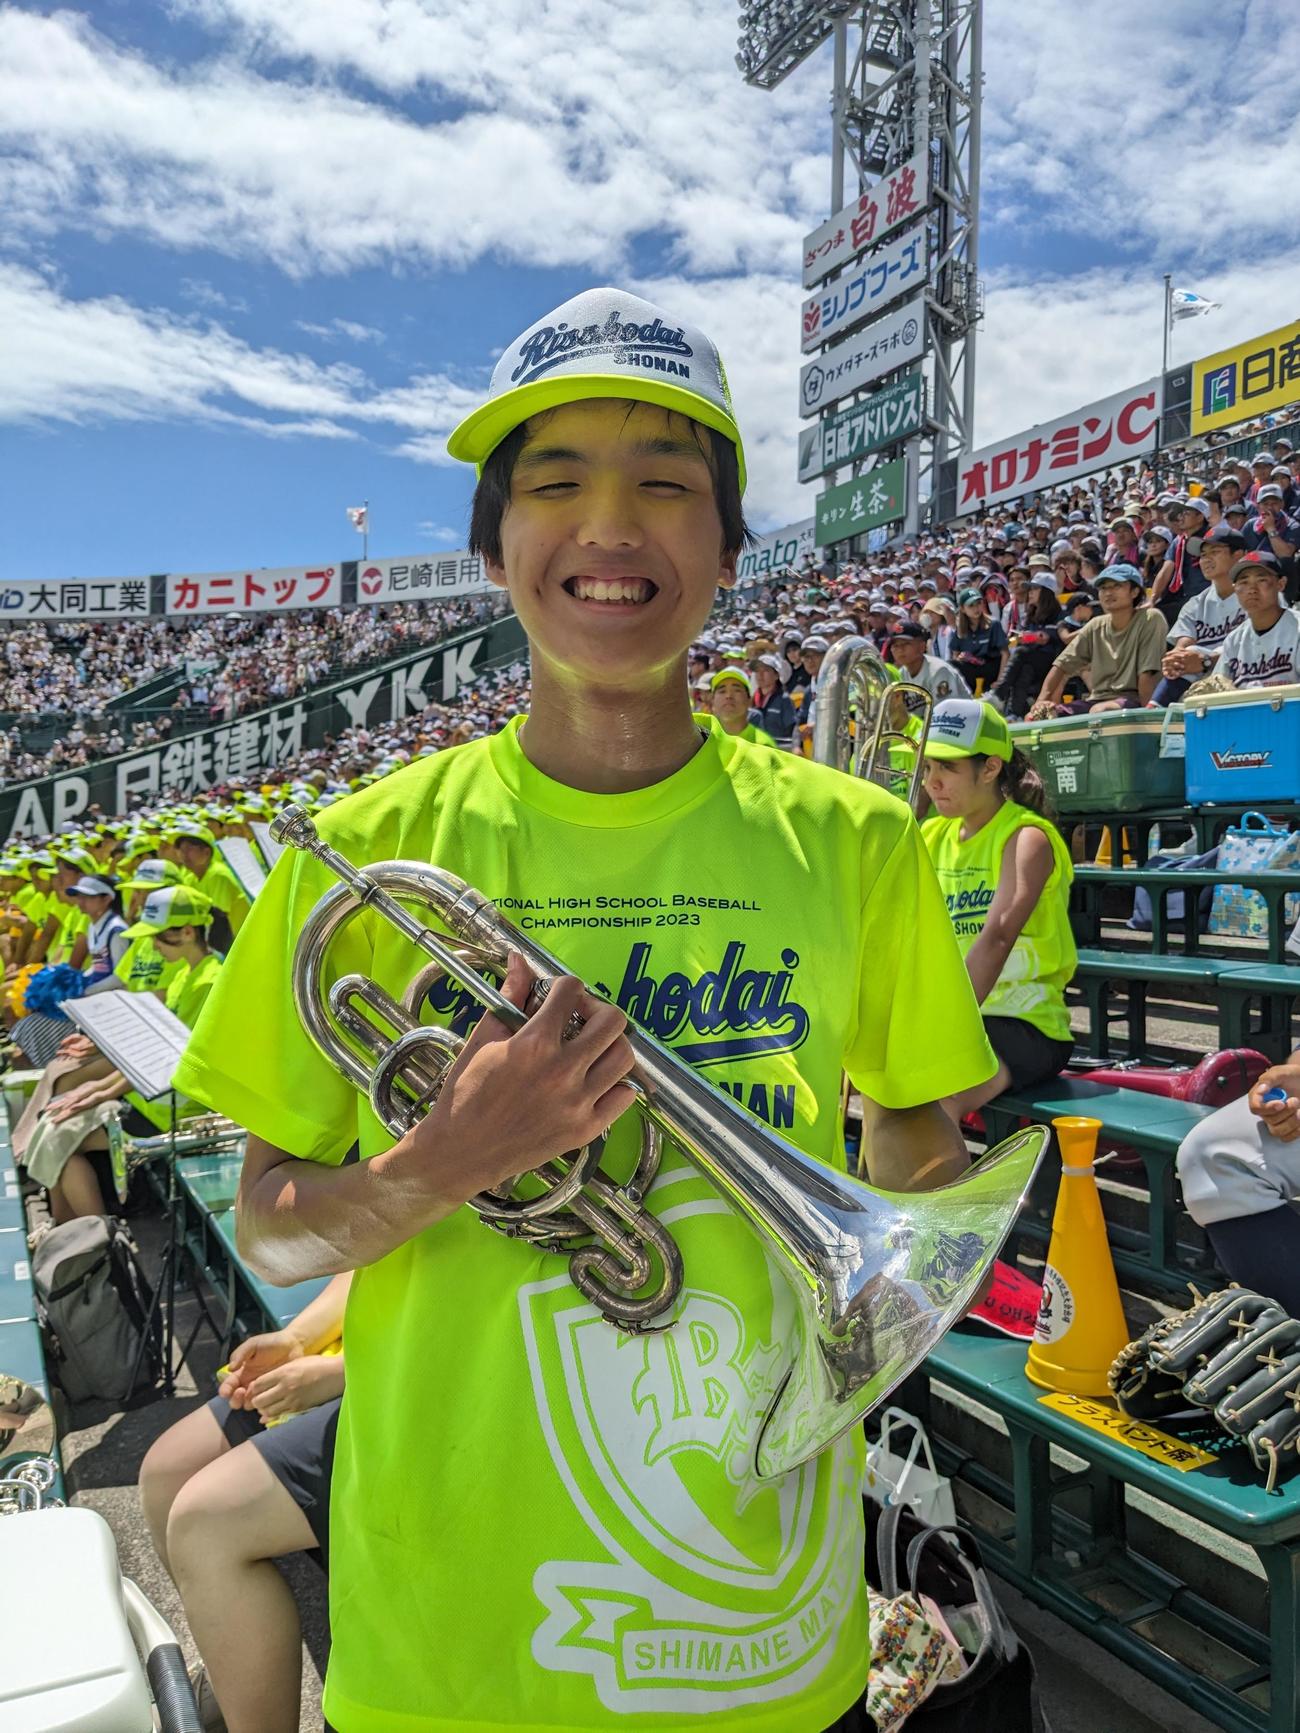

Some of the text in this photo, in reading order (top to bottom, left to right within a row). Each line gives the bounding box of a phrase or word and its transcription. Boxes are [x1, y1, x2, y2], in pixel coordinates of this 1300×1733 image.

[805, 166, 920, 268] さつま 白波
[821, 236, 921, 329] シノブフーズ
[613, 352, 690, 379] SHONAN
[825, 330, 901, 382] ウメダチーズラボ
[960, 391, 1157, 504] オロナミンC
[821, 477, 889, 526] キリン 生茶
[387, 557, 488, 592] 尼崎信用
[740, 538, 798, 577] mato
[28, 580, 147, 614] 大同工業
[173, 567, 335, 609] カニトップ
[336, 637, 484, 732] YKK
[116, 702, 309, 815] 日鉄建材
[1055, 765, 1077, 794] 南
[492, 894, 762, 911] TIONAL HIGH SCHOOL BASEBALL
[521, 913, 701, 929] CHAMPIONSHIP 2023
[634, 1630, 791, 1673] SHIMANE
